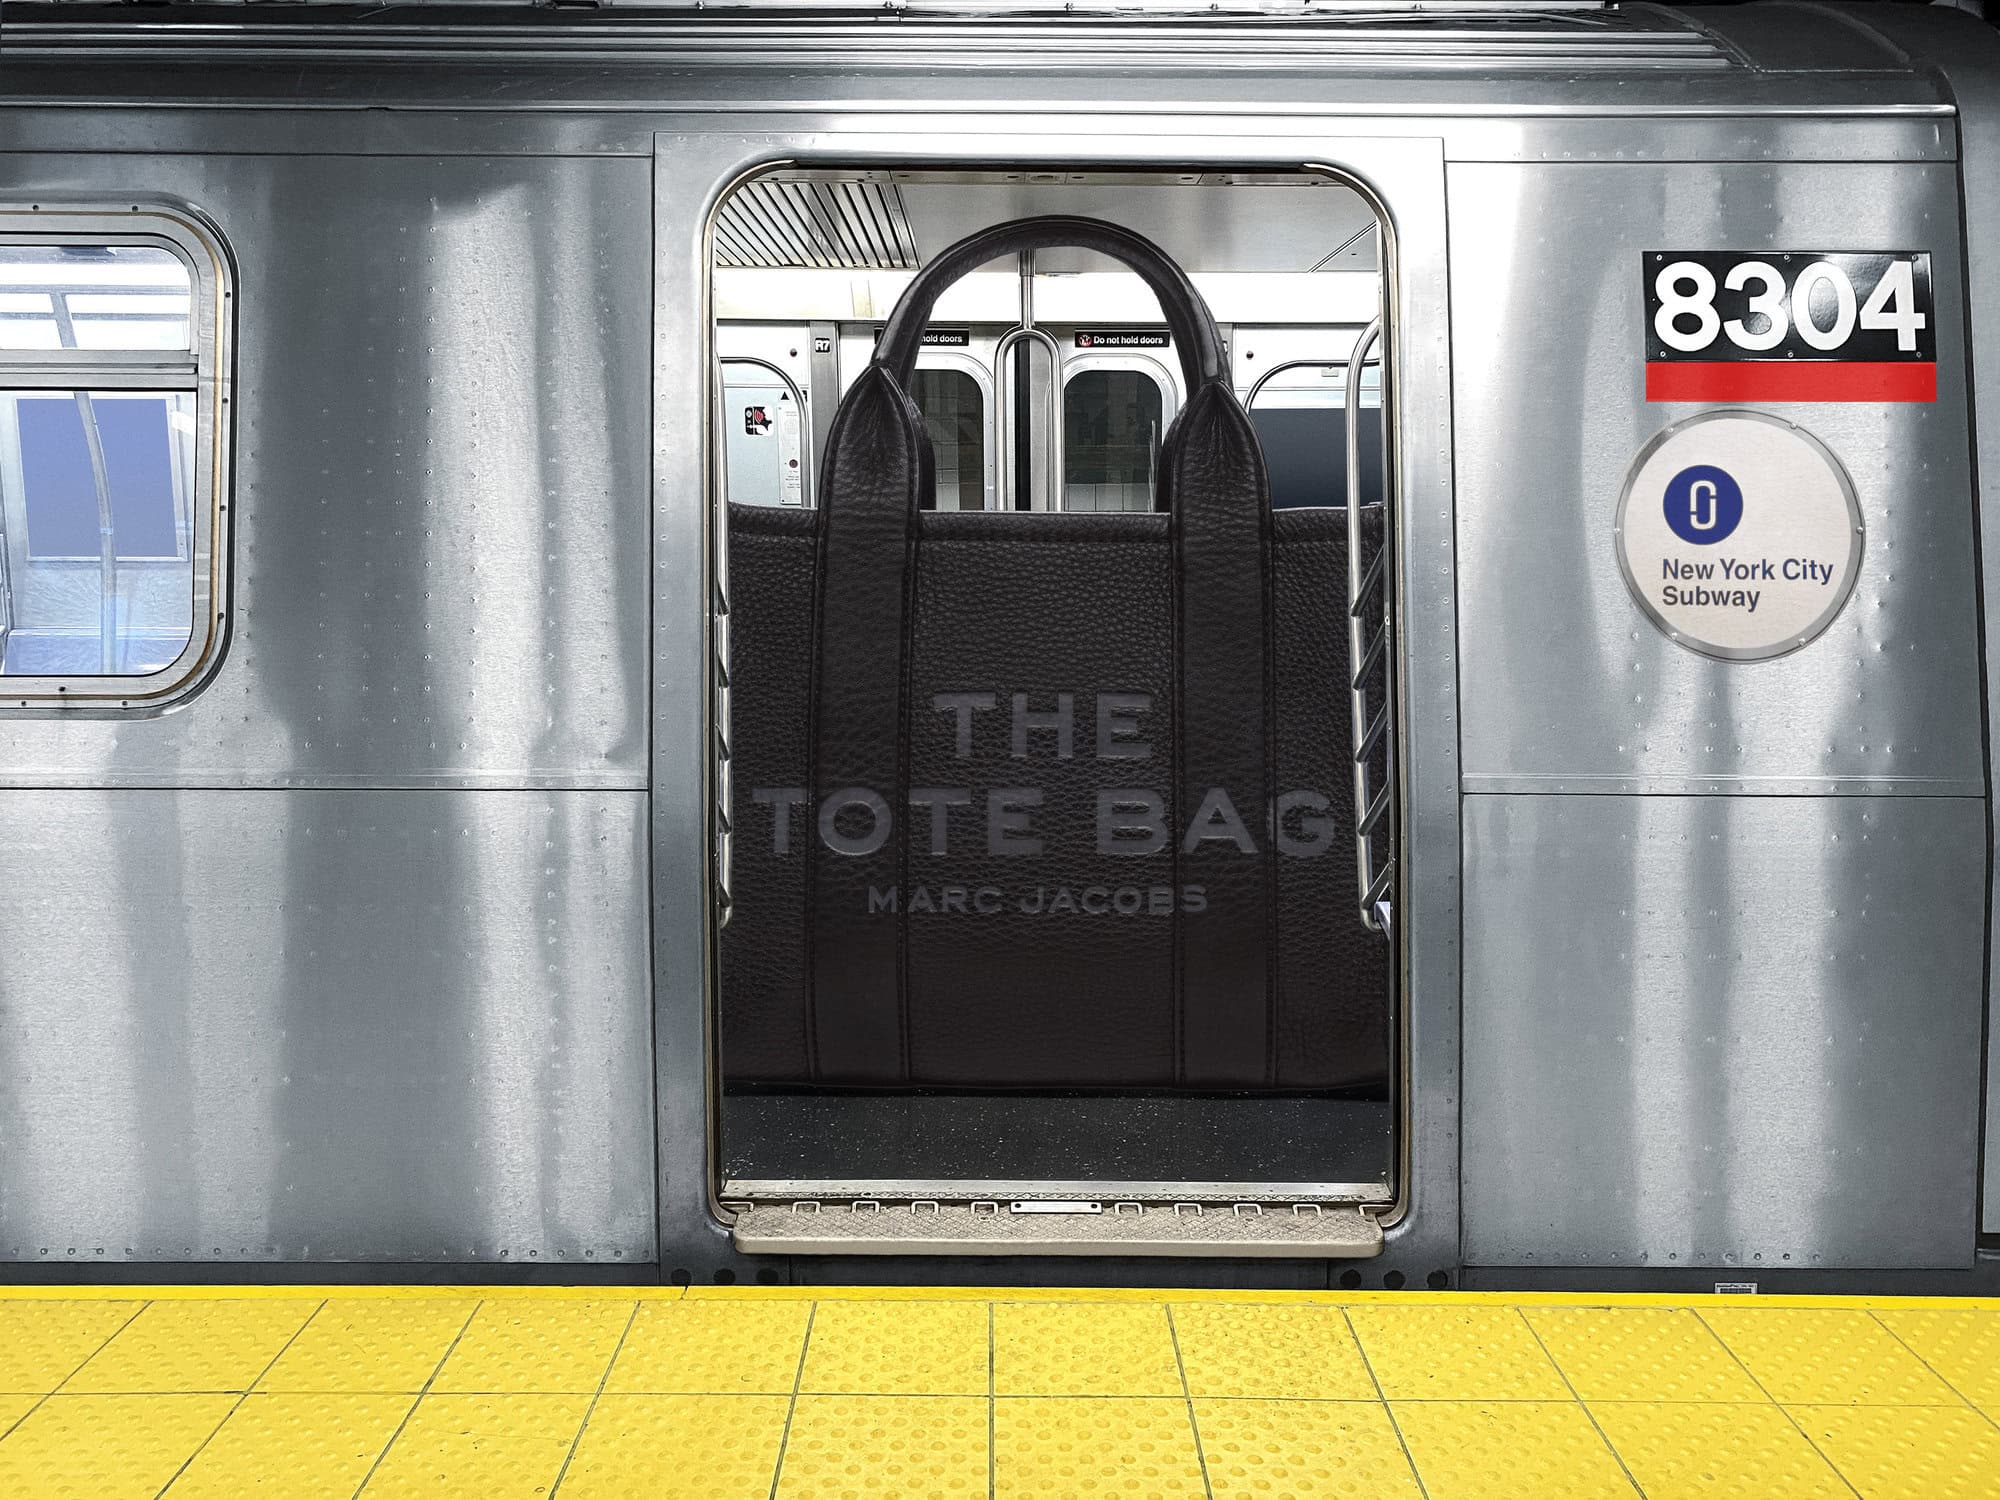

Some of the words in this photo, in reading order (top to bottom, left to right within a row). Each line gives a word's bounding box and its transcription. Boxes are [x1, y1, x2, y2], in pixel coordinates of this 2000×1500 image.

[1654, 260, 1926, 352] 8304
[939, 334, 963, 343] doors
[1093, 336, 1105, 344] Do
[1106, 336, 1120, 344] not
[1121, 336, 1138, 344] hold
[1140, 336, 1164, 344] doors
[1662, 558, 1714, 580] New
[1720, 558, 1776, 580] York
[1782, 558, 1834, 586] City
[1662, 585, 1761, 613] Subway
[933, 692, 1153, 759] THE
[751, 786, 1043, 857] TOTE
[1096, 786, 1336, 857] BAG
[867, 884, 1003, 914] MARC
[1020, 884, 1208, 915] JACOBS
